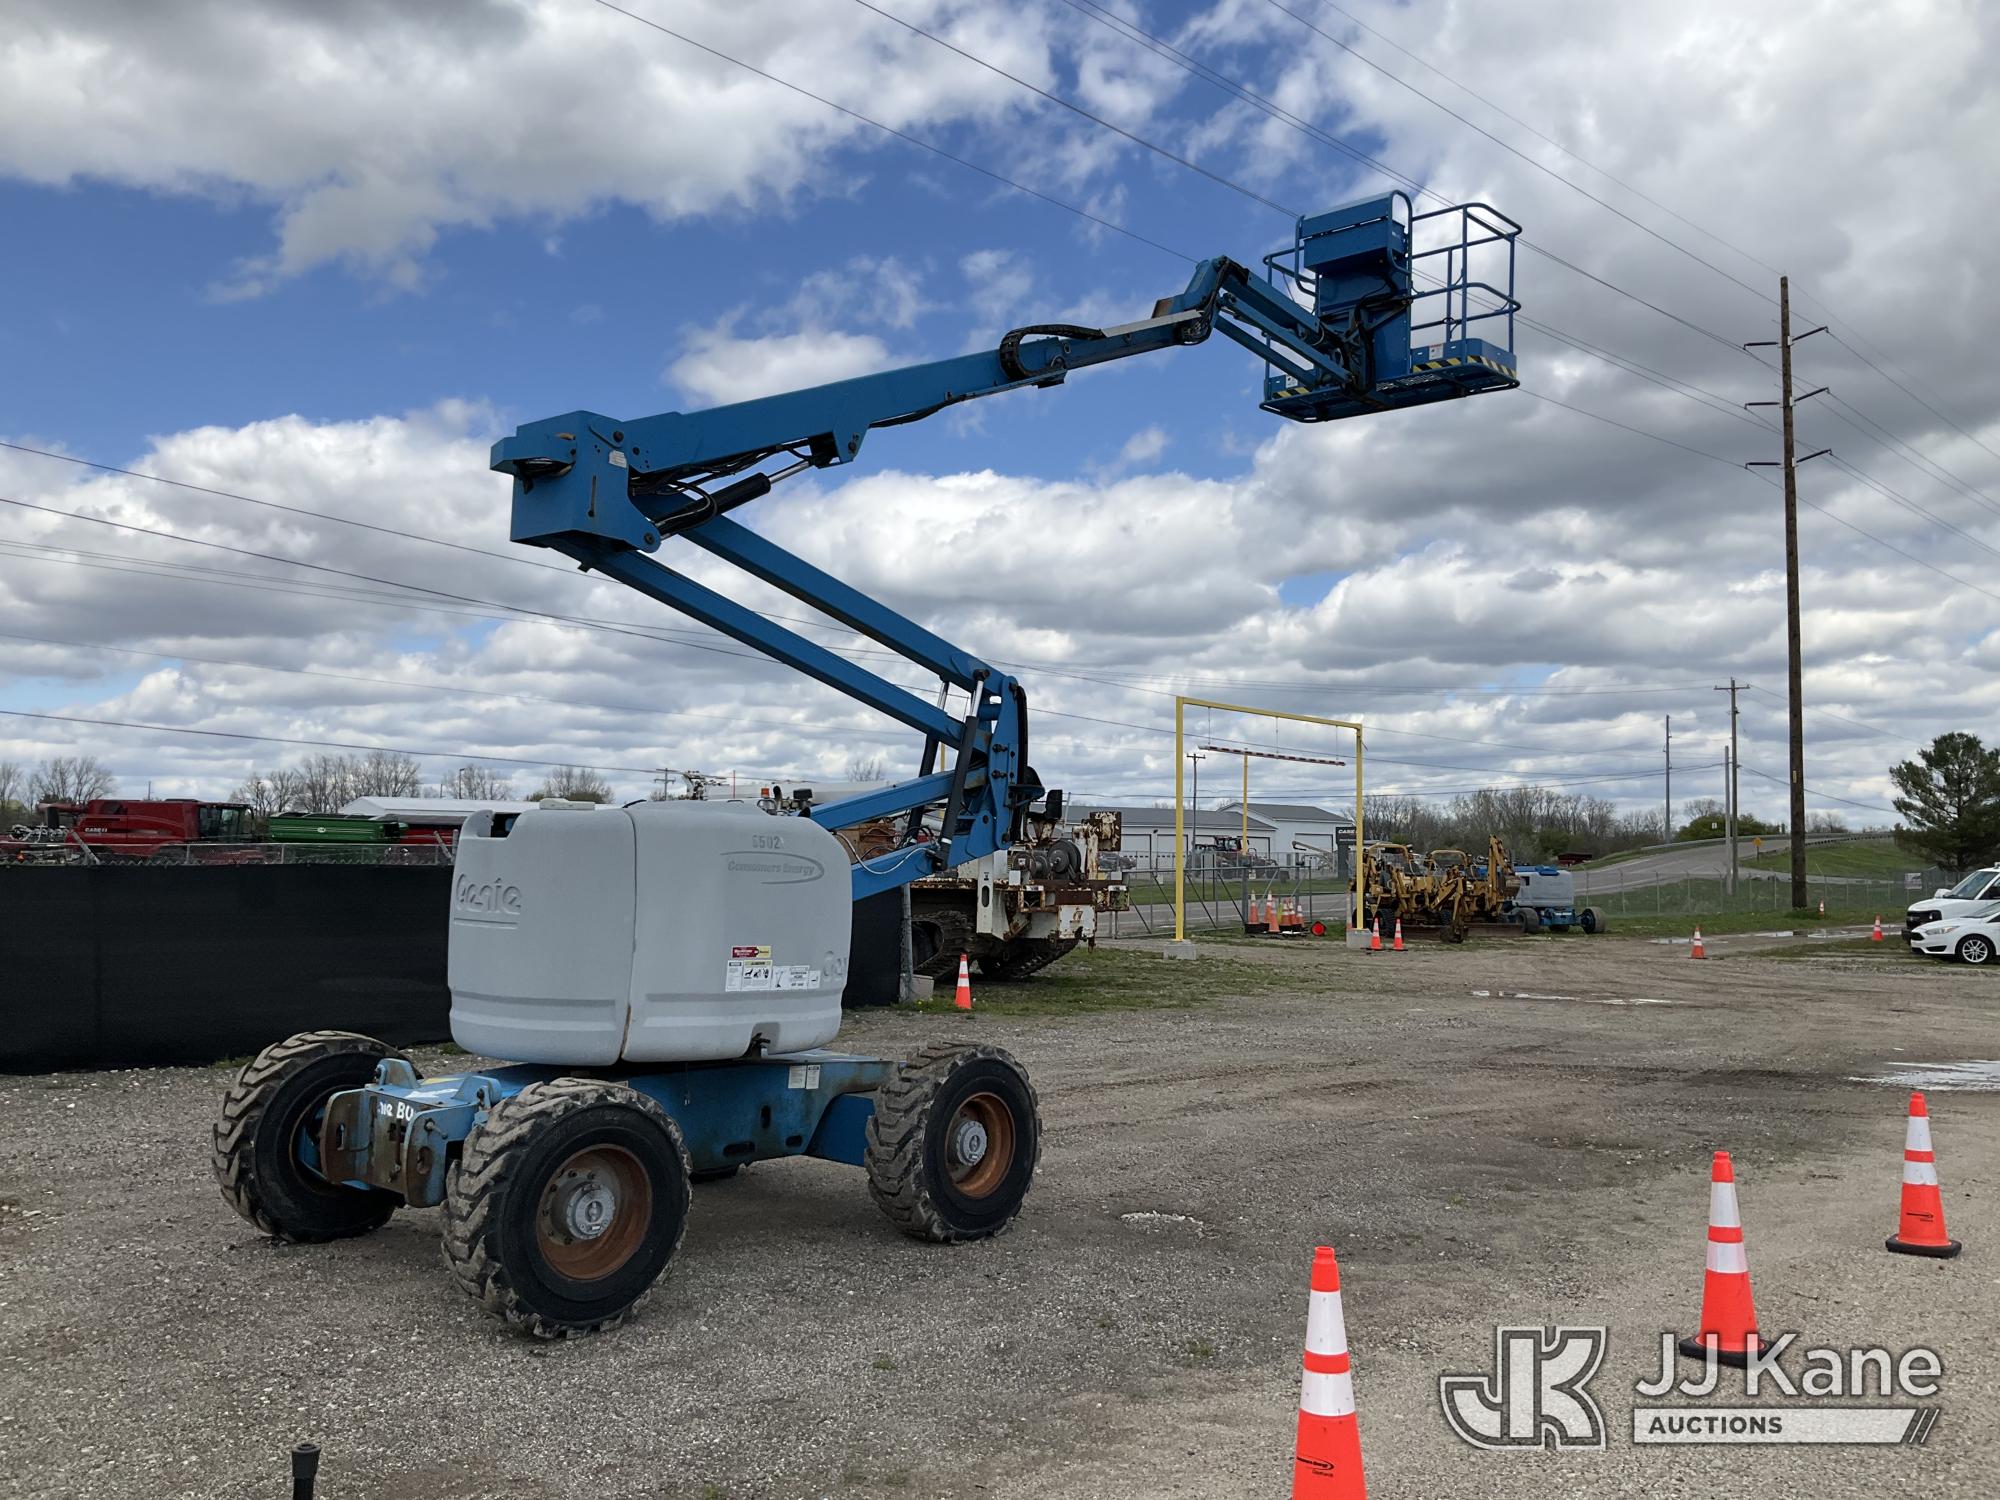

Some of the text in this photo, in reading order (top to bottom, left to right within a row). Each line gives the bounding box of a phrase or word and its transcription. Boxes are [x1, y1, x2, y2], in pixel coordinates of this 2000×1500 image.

[728, 860, 815, 876] Consumers Energy
[456, 873, 522, 914] Genie
